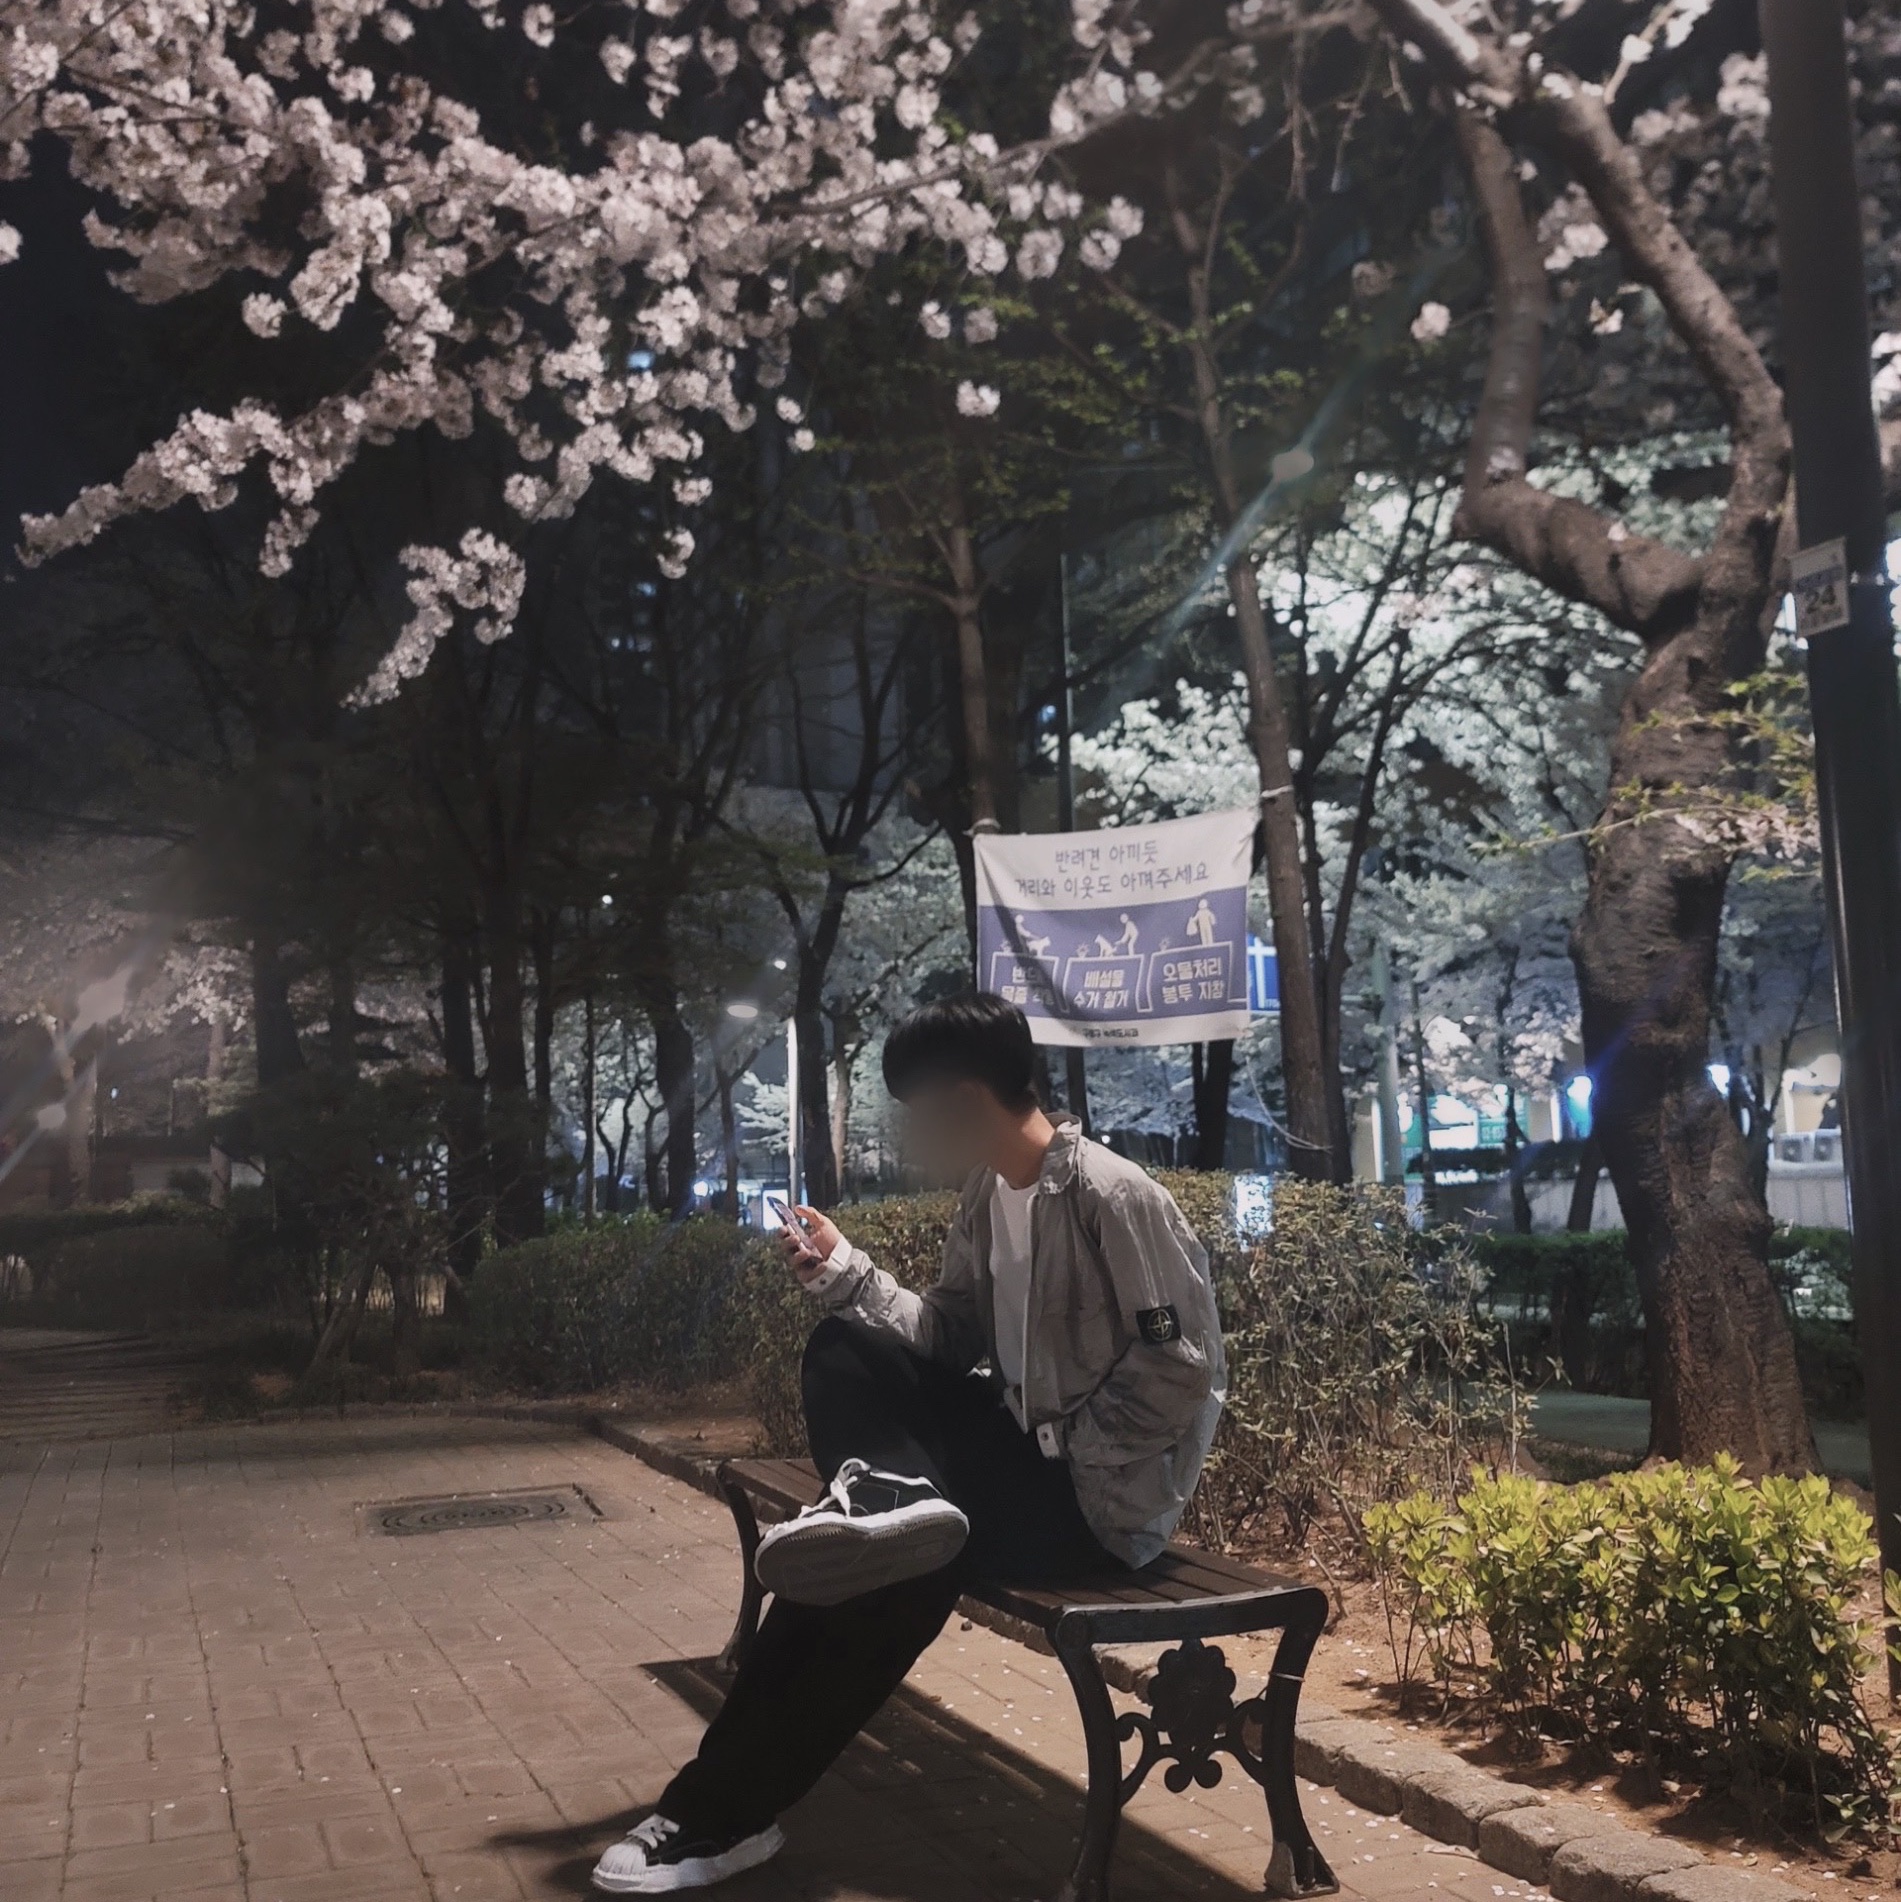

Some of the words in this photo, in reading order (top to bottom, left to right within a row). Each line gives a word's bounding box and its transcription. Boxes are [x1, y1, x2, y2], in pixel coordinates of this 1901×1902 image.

[1055, 847, 1100, 873] 반려견
[1109, 840, 1159, 863] 아끼듯
[1064, 875, 1112, 899] 이웃도
[1120, 863, 1209, 891] 아껴주세요
[1084, 969, 1125, 988] 배설물
[1163, 957, 1222, 982] 오물처리
[1162, 983, 1193, 1004] 봉투
